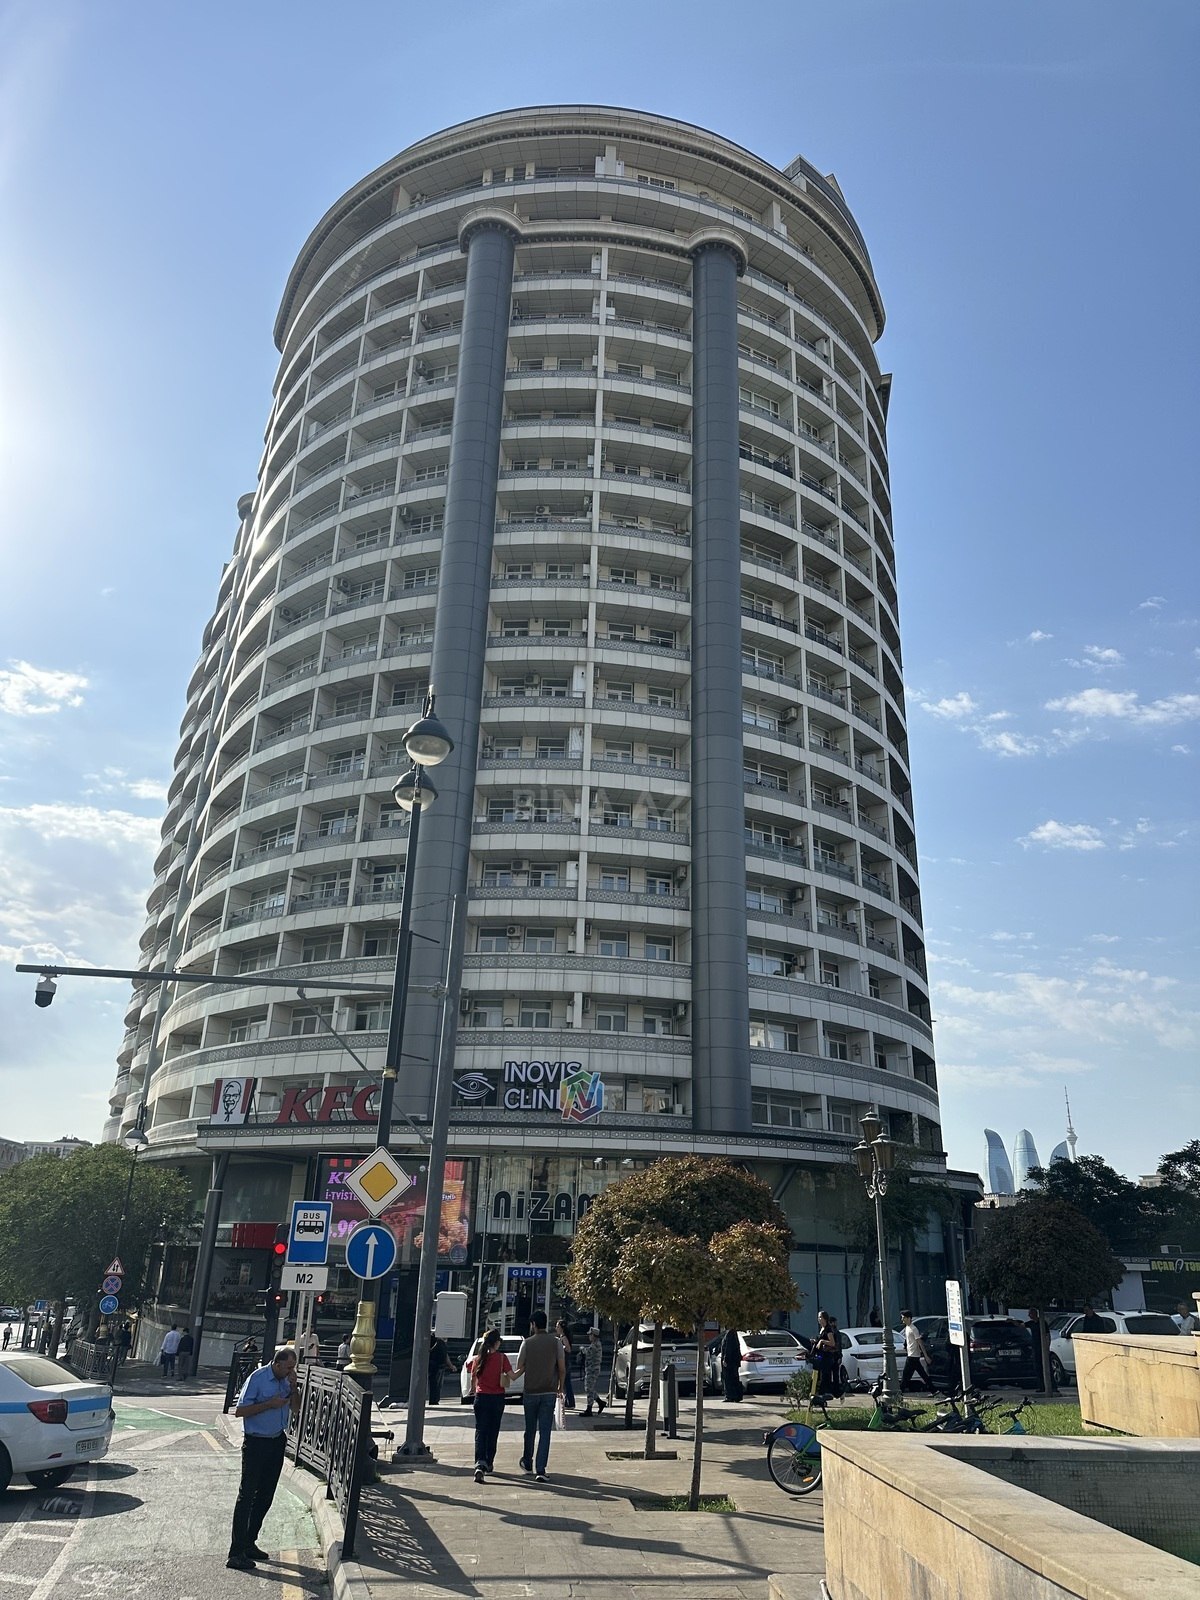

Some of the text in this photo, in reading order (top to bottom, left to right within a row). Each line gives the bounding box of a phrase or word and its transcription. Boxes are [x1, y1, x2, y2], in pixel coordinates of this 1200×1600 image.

[504, 1060, 582, 1084] INOVIS
[273, 1084, 381, 1124] KFC
[504, 1087, 563, 1110] CLINI
[302, 1212, 321, 1220] BUS
[295, 1273, 314, 1284] M2
[512, 1267, 543, 1278] GİRİŞ
